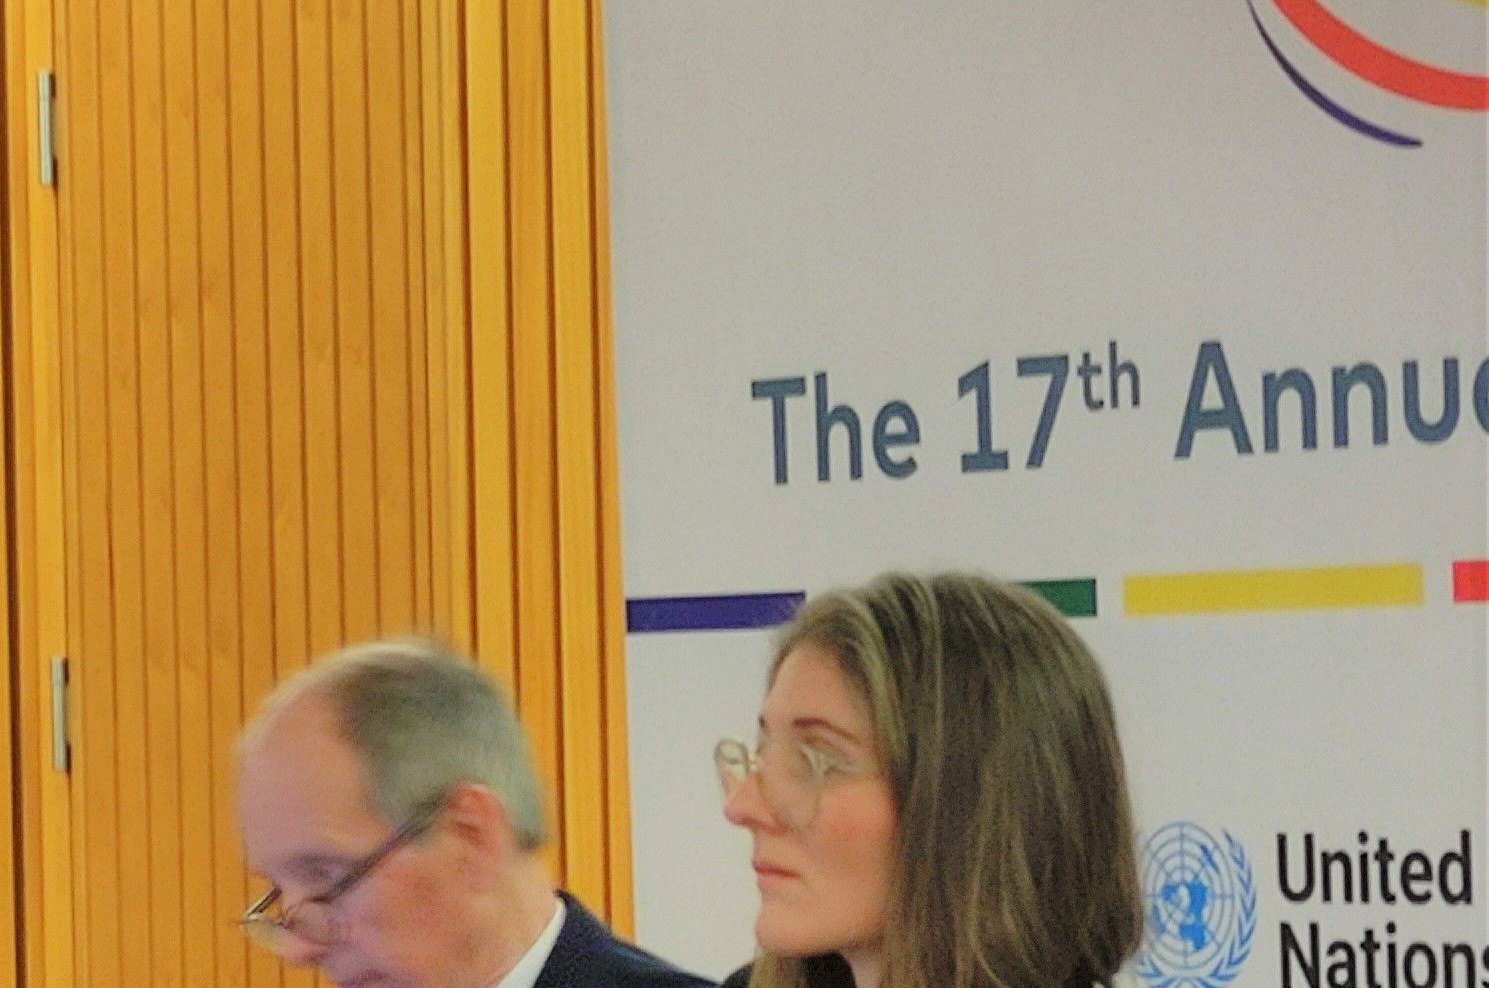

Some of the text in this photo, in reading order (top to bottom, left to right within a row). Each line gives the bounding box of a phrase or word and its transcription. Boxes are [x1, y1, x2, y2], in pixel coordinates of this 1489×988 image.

[750, 372, 922, 485] The
[957, 340, 1142, 473] 17th
[1277, 829, 1473, 905] United
